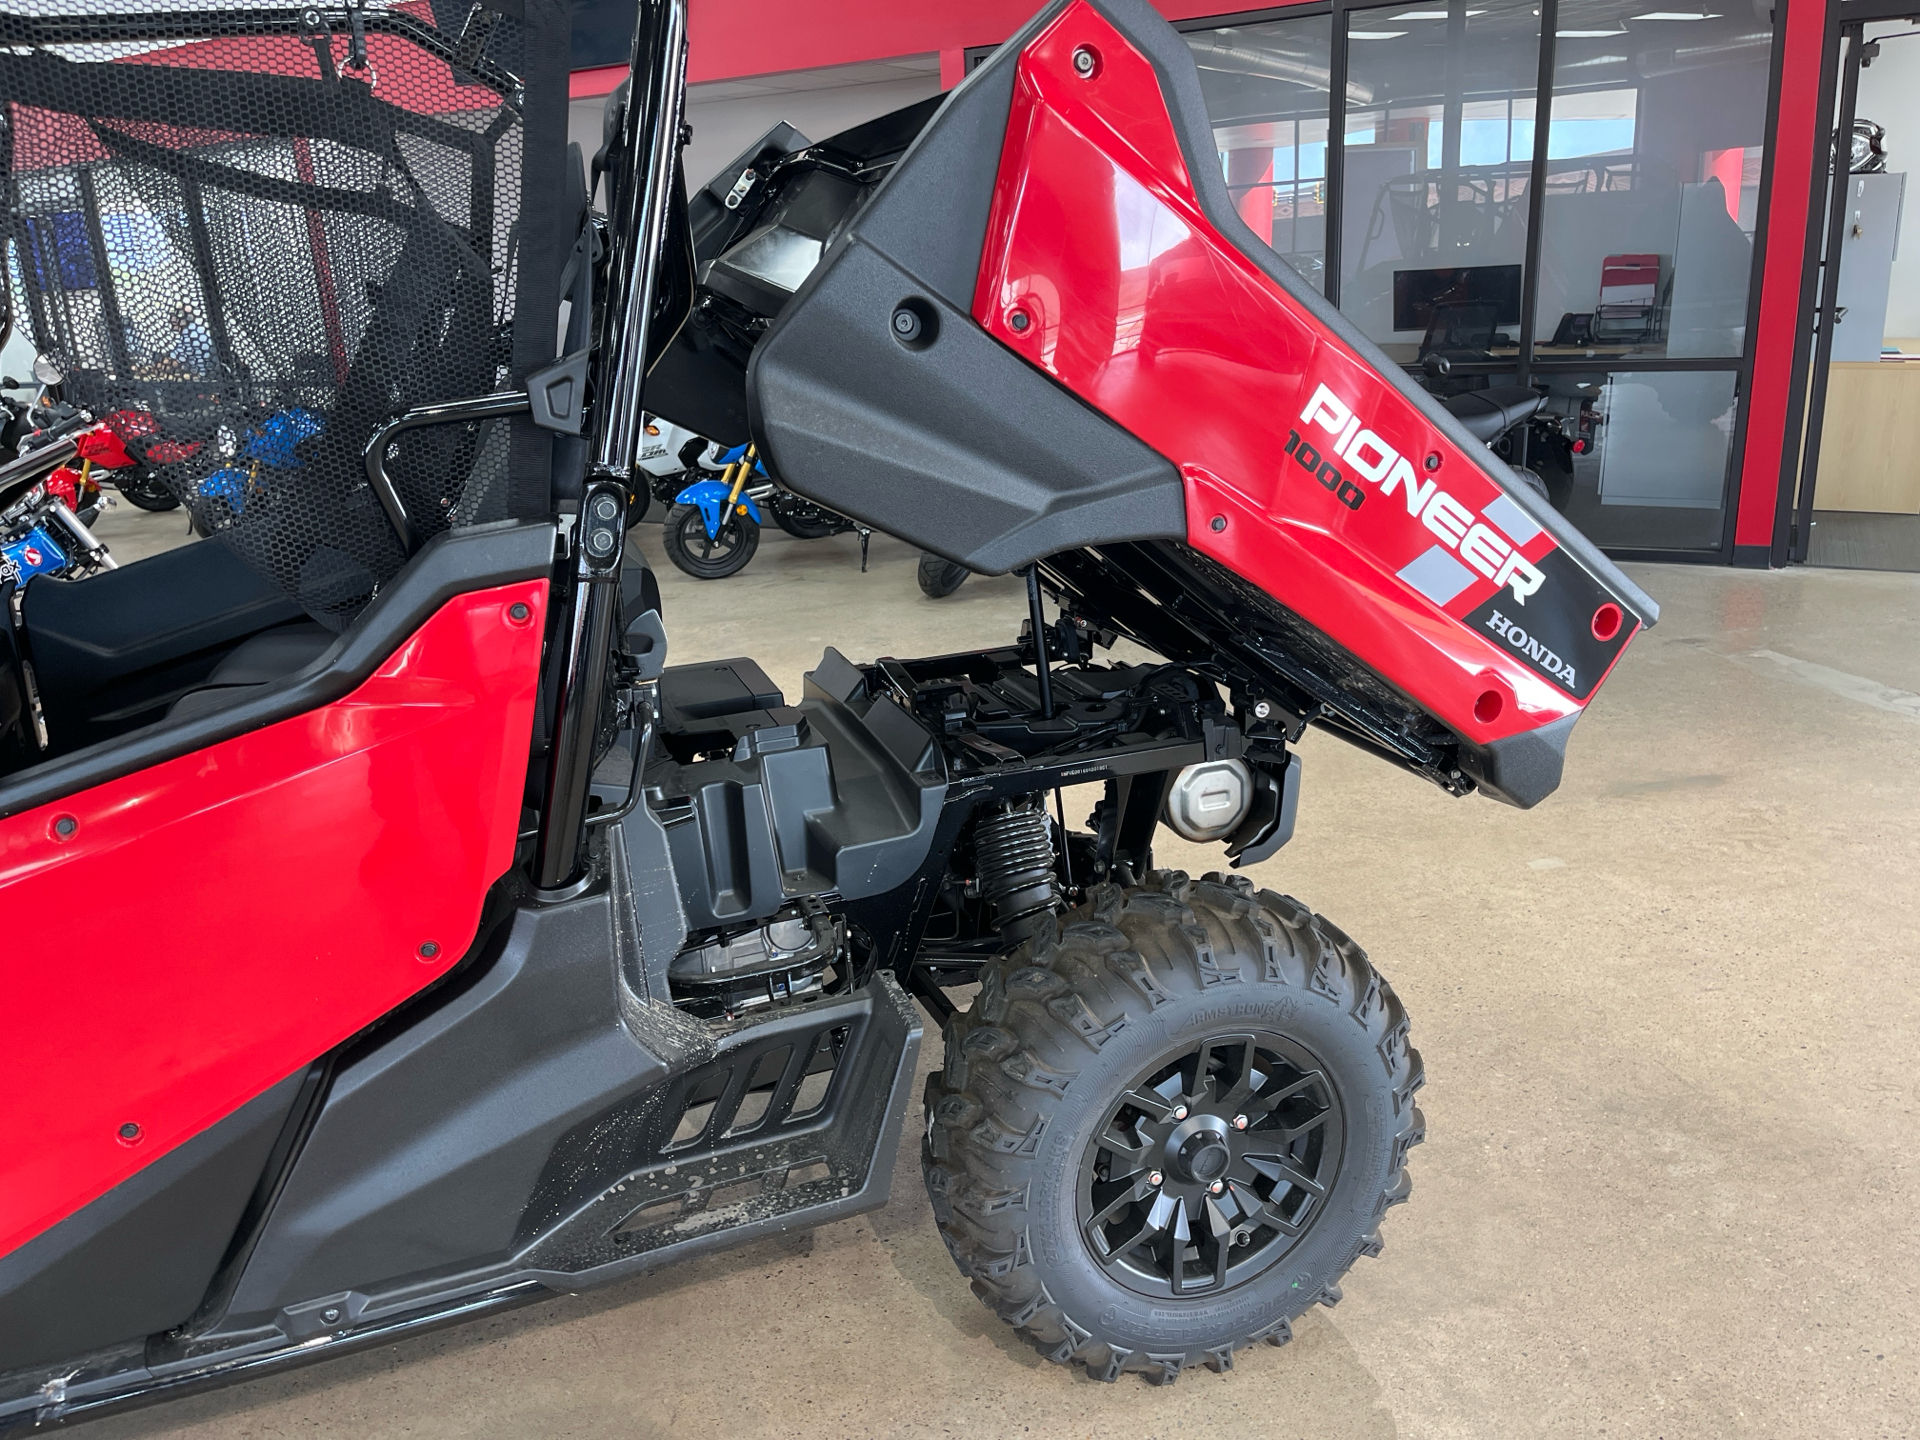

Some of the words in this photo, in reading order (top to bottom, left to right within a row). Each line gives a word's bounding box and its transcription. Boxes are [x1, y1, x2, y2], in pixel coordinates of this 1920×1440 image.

[1284, 429, 1366, 511] 1000
[1300, 382, 1547, 607] PIONEER
[1486, 608, 1576, 689] HONDA
